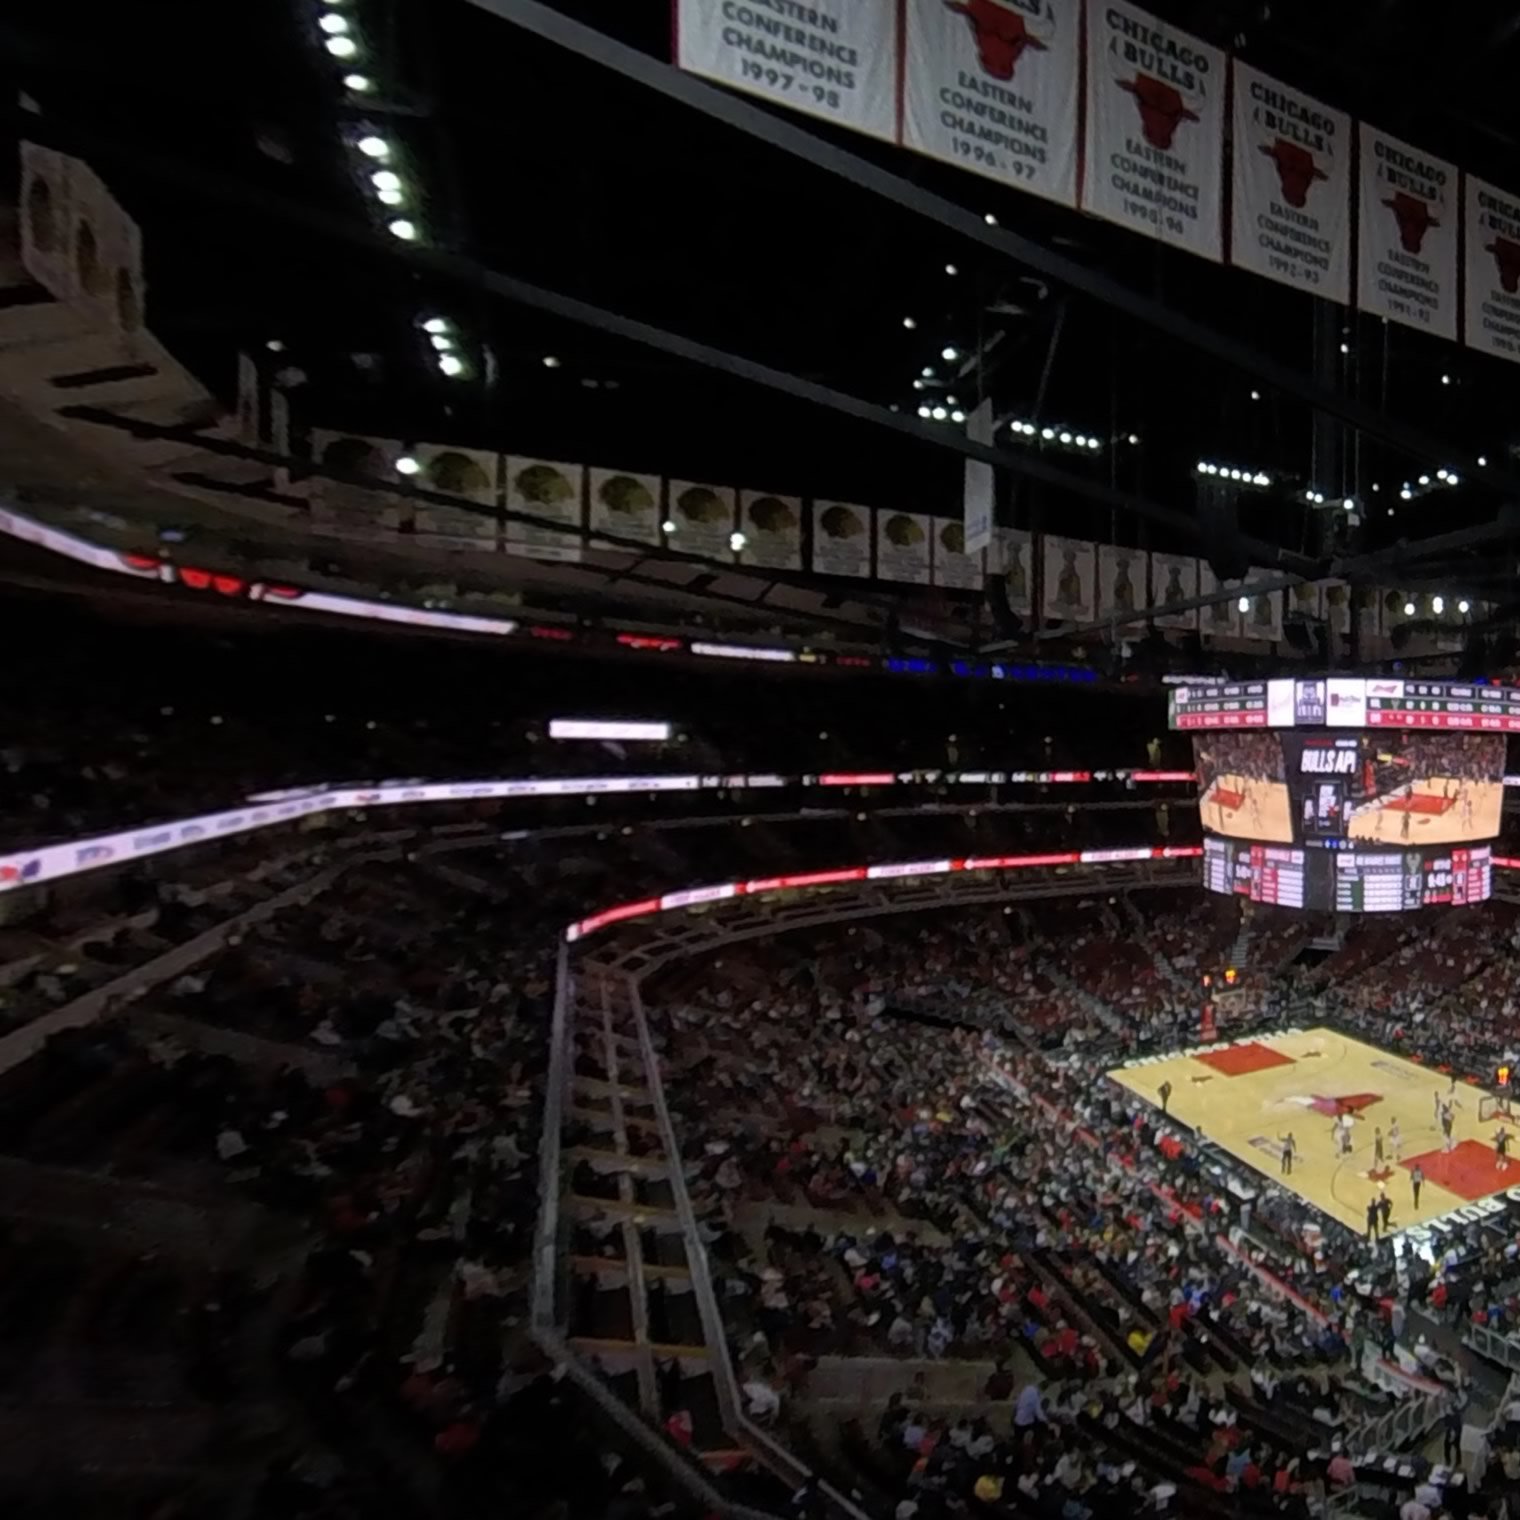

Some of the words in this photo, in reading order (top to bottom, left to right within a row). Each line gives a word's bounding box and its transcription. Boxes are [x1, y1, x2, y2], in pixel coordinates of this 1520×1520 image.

[722, 1, 858, 66] CONFERENCE
[1106, 8, 1209, 74] CHICAGO
[722, 27, 856, 89] CHAMPIONS
[1123, 45, 1195, 91] BULLS
[939, 87, 1048, 143] CONFERENCE
[958, 71, 1033, 114] EASTERN
[1250, 81, 1335, 136] CHICAGO
[940, 111, 1047, 164] CHAMPIONS
[1265, 110, 1324, 153] BULLS
[1110, 153, 1199, 202] CONFERENCE
[1126, 138, 1187, 176] EASTERN
[1374, 140, 1446, 187] CHICAGO
[1111, 175, 1198, 220] CHAMPIONS
[1387, 167, 1437, 201] BULLS
[1270, 202, 1320, 231] EASTERN
[1300, 749, 1336, 773] BULLS
[1406, 1196, 1506, 1242] BULLS
